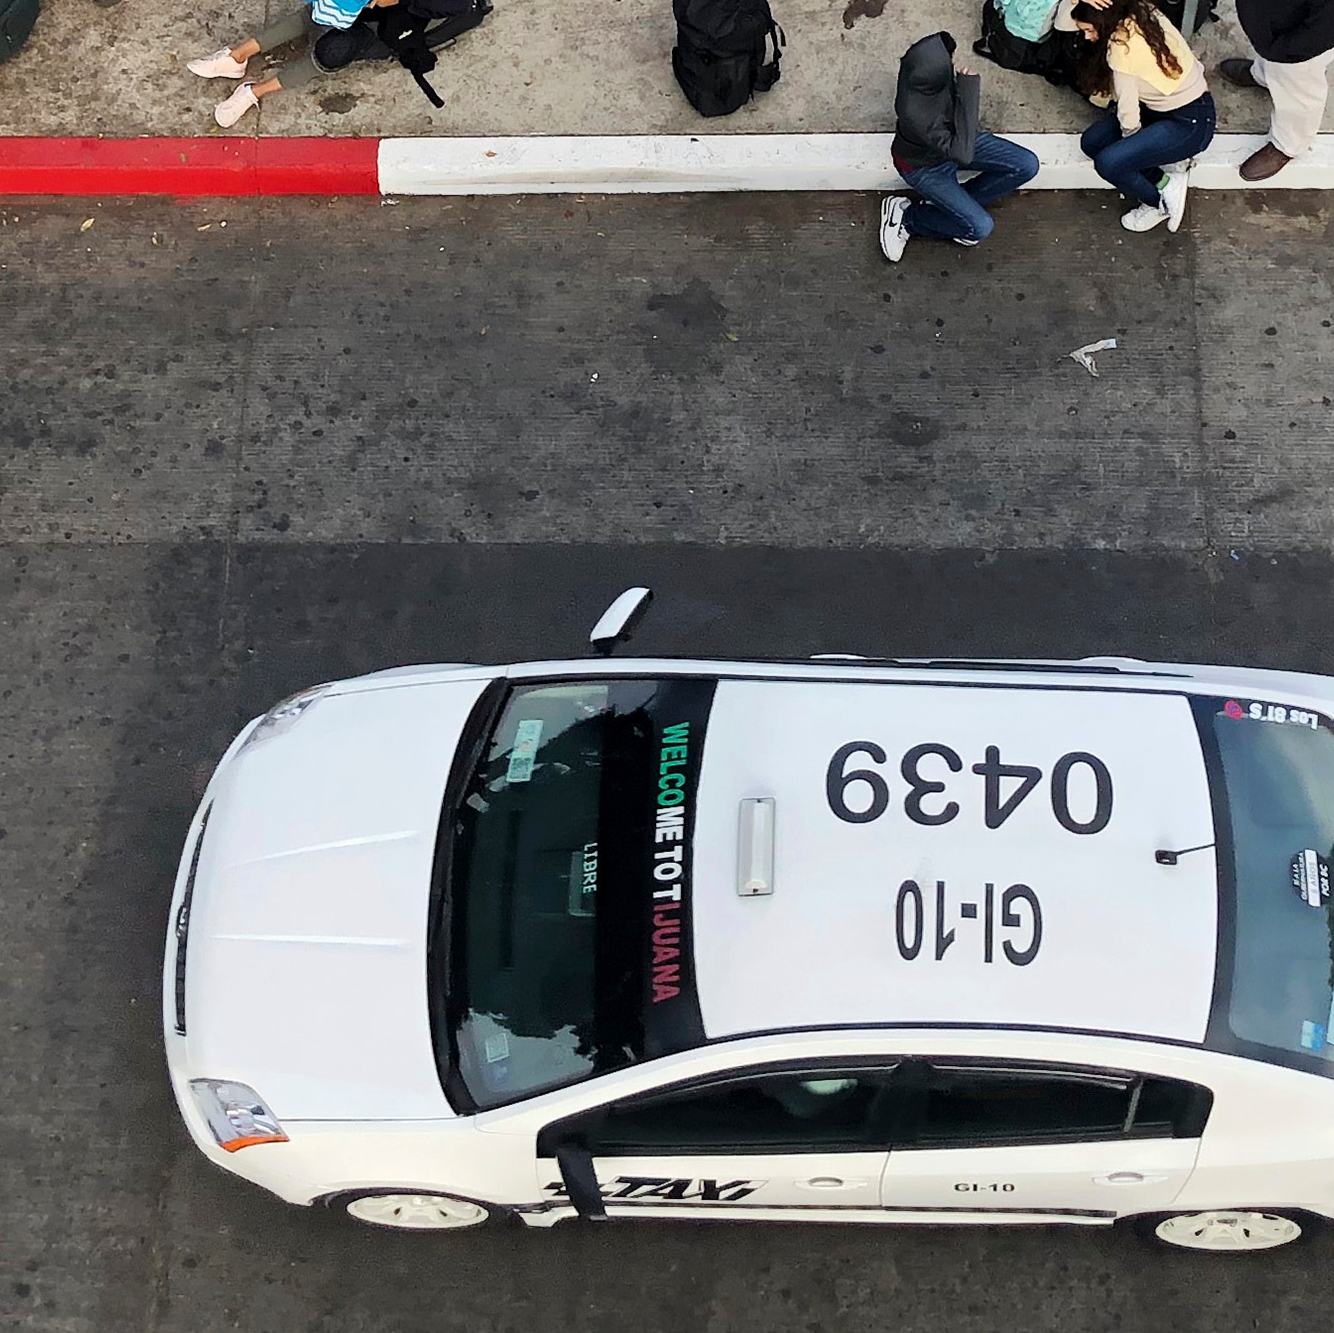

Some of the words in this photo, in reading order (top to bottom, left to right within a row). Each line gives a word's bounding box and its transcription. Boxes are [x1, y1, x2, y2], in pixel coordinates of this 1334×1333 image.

[1289, 709, 1318, 731] Los
[654, 721, 690, 844] WELCOME
[825, 739, 1114, 835] 0439
[582, 842, 599, 894] LIBRE
[652, 845, 684, 881] TO
[651, 883, 682, 1003] TIJUANA
[894, 879, 1043, 966] GI-10
[954, 1183, 1015, 1192] GI-10
